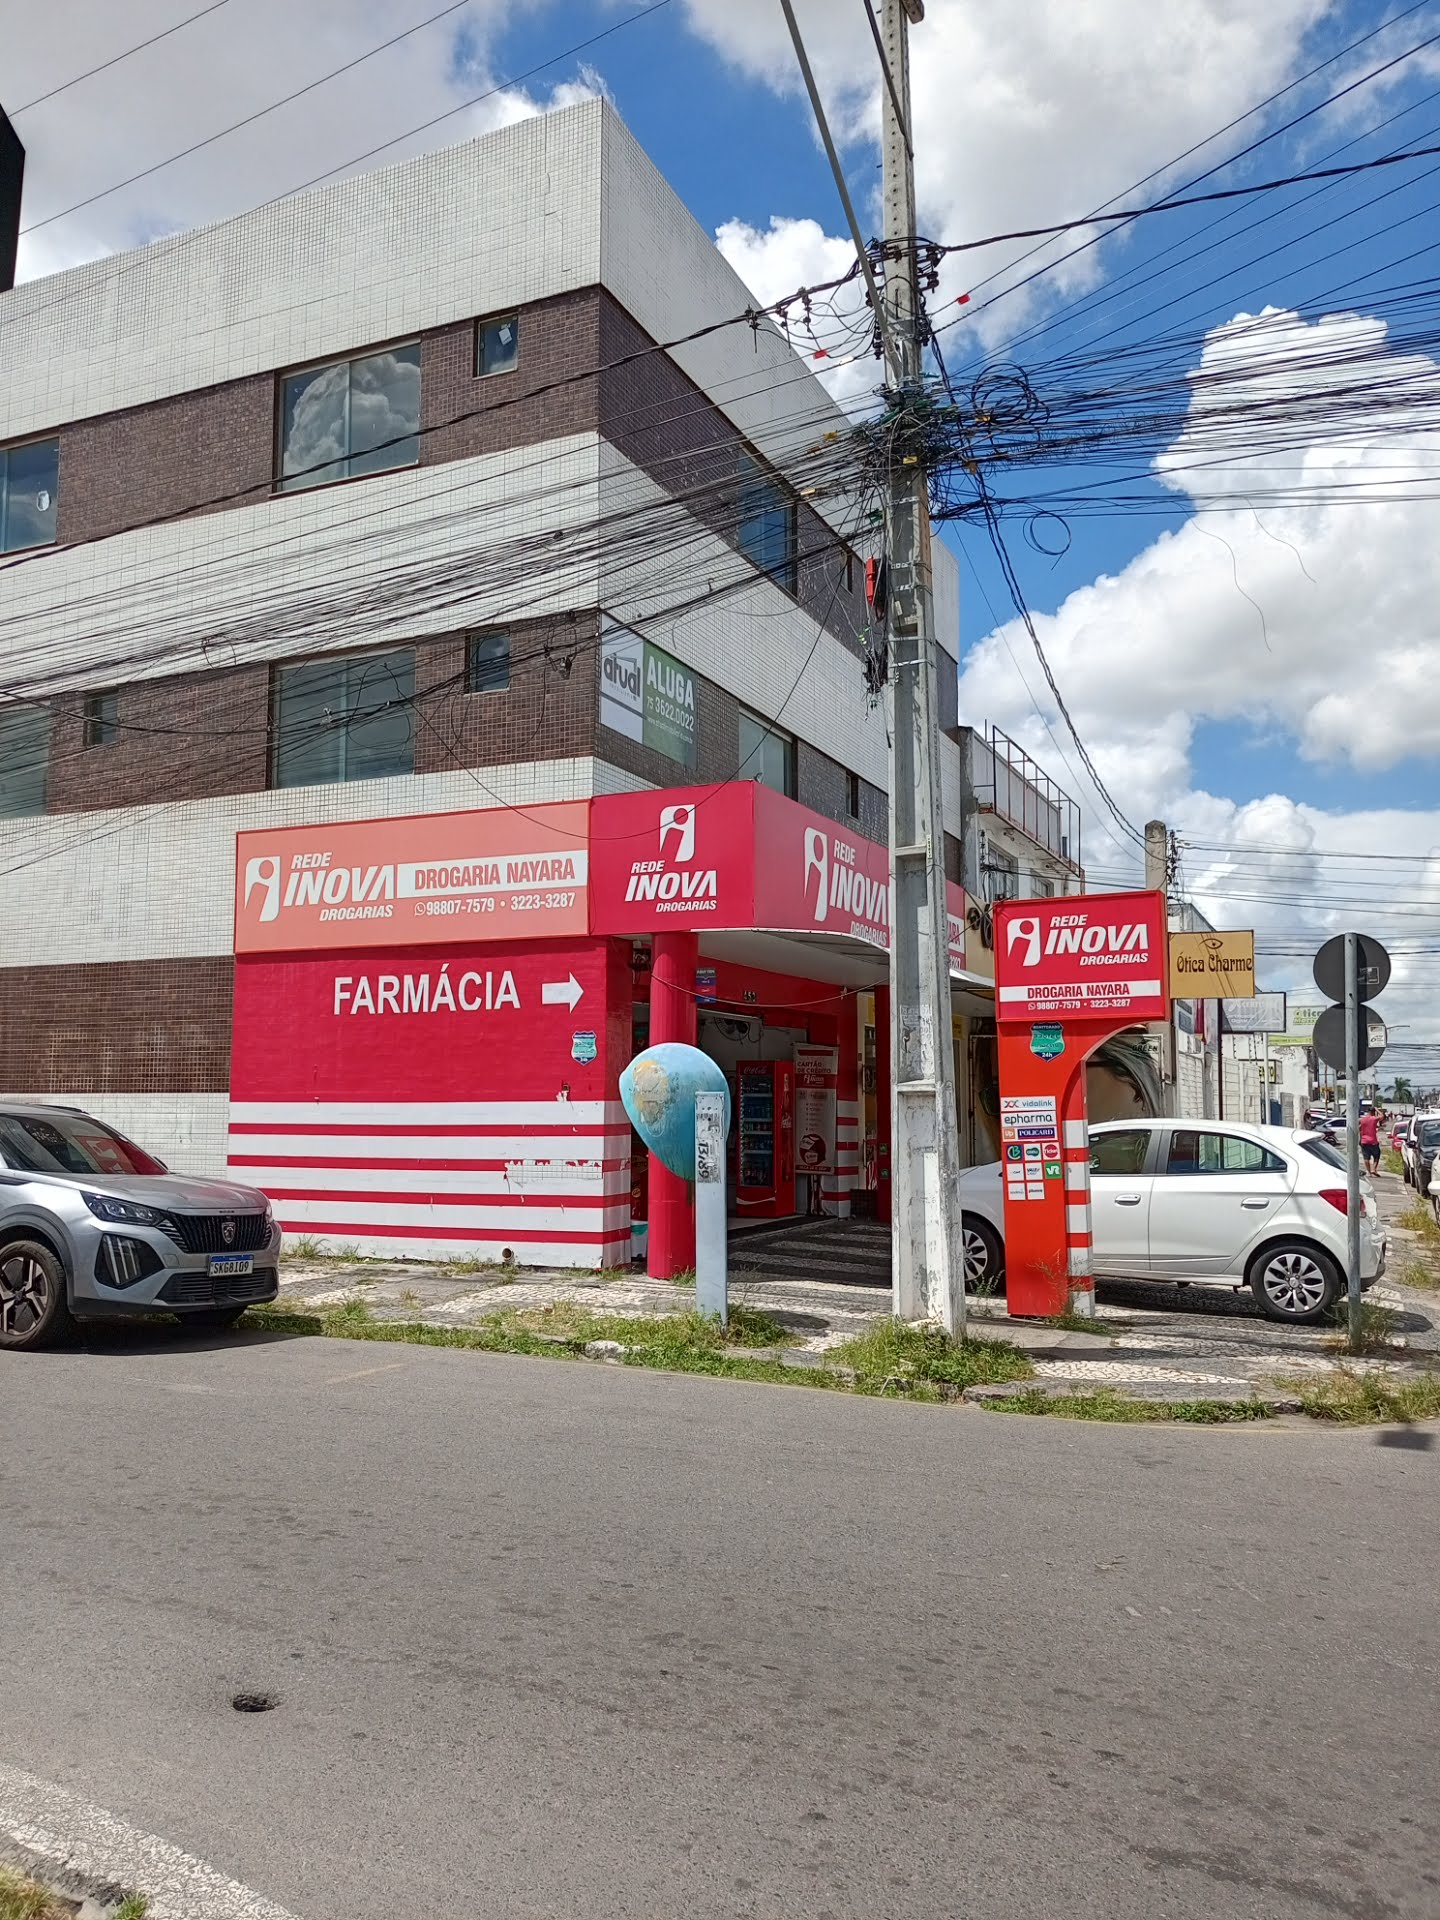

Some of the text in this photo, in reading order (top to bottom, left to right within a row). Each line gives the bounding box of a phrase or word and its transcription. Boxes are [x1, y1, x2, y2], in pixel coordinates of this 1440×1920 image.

[604, 653, 641, 697] atual
[647, 656, 694, 711] ALUGA
[291, 852, 332, 869] REDE
[833, 838, 856, 866] REDE
[414, 858, 575, 890] DROGARIA NAYARA
[631, 859, 665, 874] REDE
[283, 864, 395, 907] INOVA
[624, 870, 717, 902] INOVA
[829, 860, 887, 926] INOVA
[319, 904, 394, 922] DROGARIAS
[426, 892, 576, 916] 98807-7579 3223-3287
[655, 900, 717, 913] DROGARIAS
[1050, 914, 1088, 927] REDE
[850, 920, 887, 947] DROGARIAS
[1044, 924, 1149, 955] INOVA
[1080, 952, 1149, 966] DROGARIAS
[1176, 952, 1252, 973] Ótica Charme
[334, 963, 520, 1015] FARMÁCIA
[1027, 984, 1130, 999] DROGARIA NAYARA
[1036, 999, 1130, 1010] 98807-7579 3223-3287
[1004, 1114, 1052, 1125] epharma
